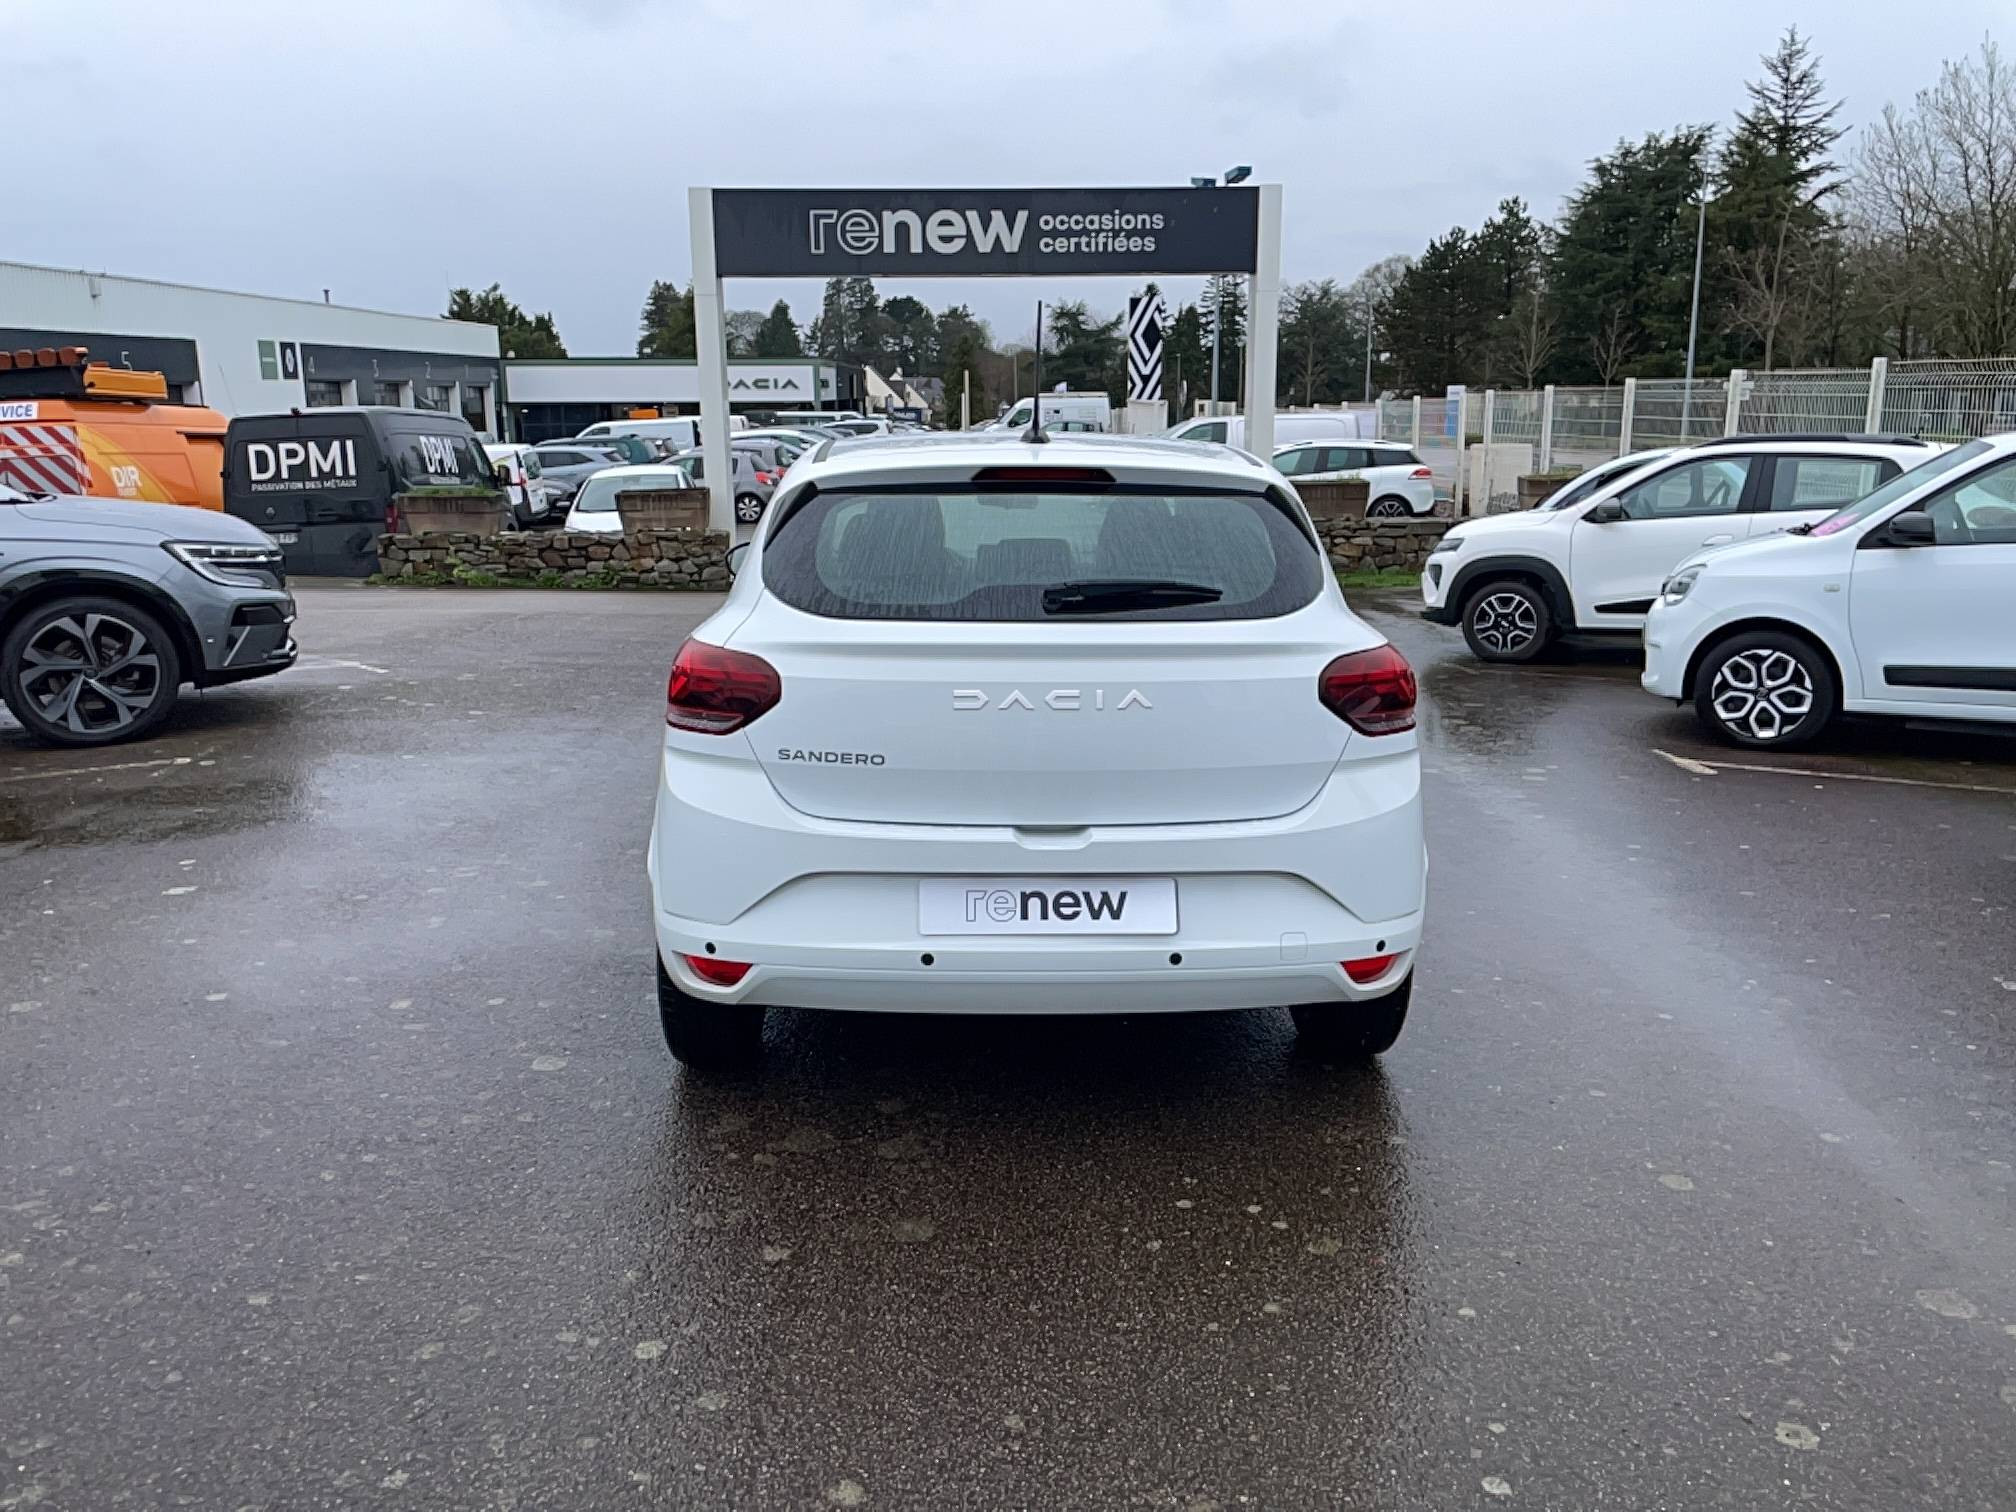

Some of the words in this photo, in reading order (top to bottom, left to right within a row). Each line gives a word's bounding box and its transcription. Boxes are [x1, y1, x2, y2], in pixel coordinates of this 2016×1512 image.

[1038, 209, 1165, 230] occasions
[809, 208, 1030, 255] renew
[1038, 232, 1156, 253] certifiées
[120, 350, 133, 371] 5
[728, 378, 800, 390] ACIA
[247, 439, 358, 481] DPMI
[419, 435, 459, 474] DPMI
[110, 465, 143, 488] DIR
[251, 481, 304, 492] PASSIVATION
[305, 480, 322, 490] DES
[952, 688, 1153, 711] DACIA
[778, 748, 886, 766] SANDERO
[965, 889, 1129, 923] renew
